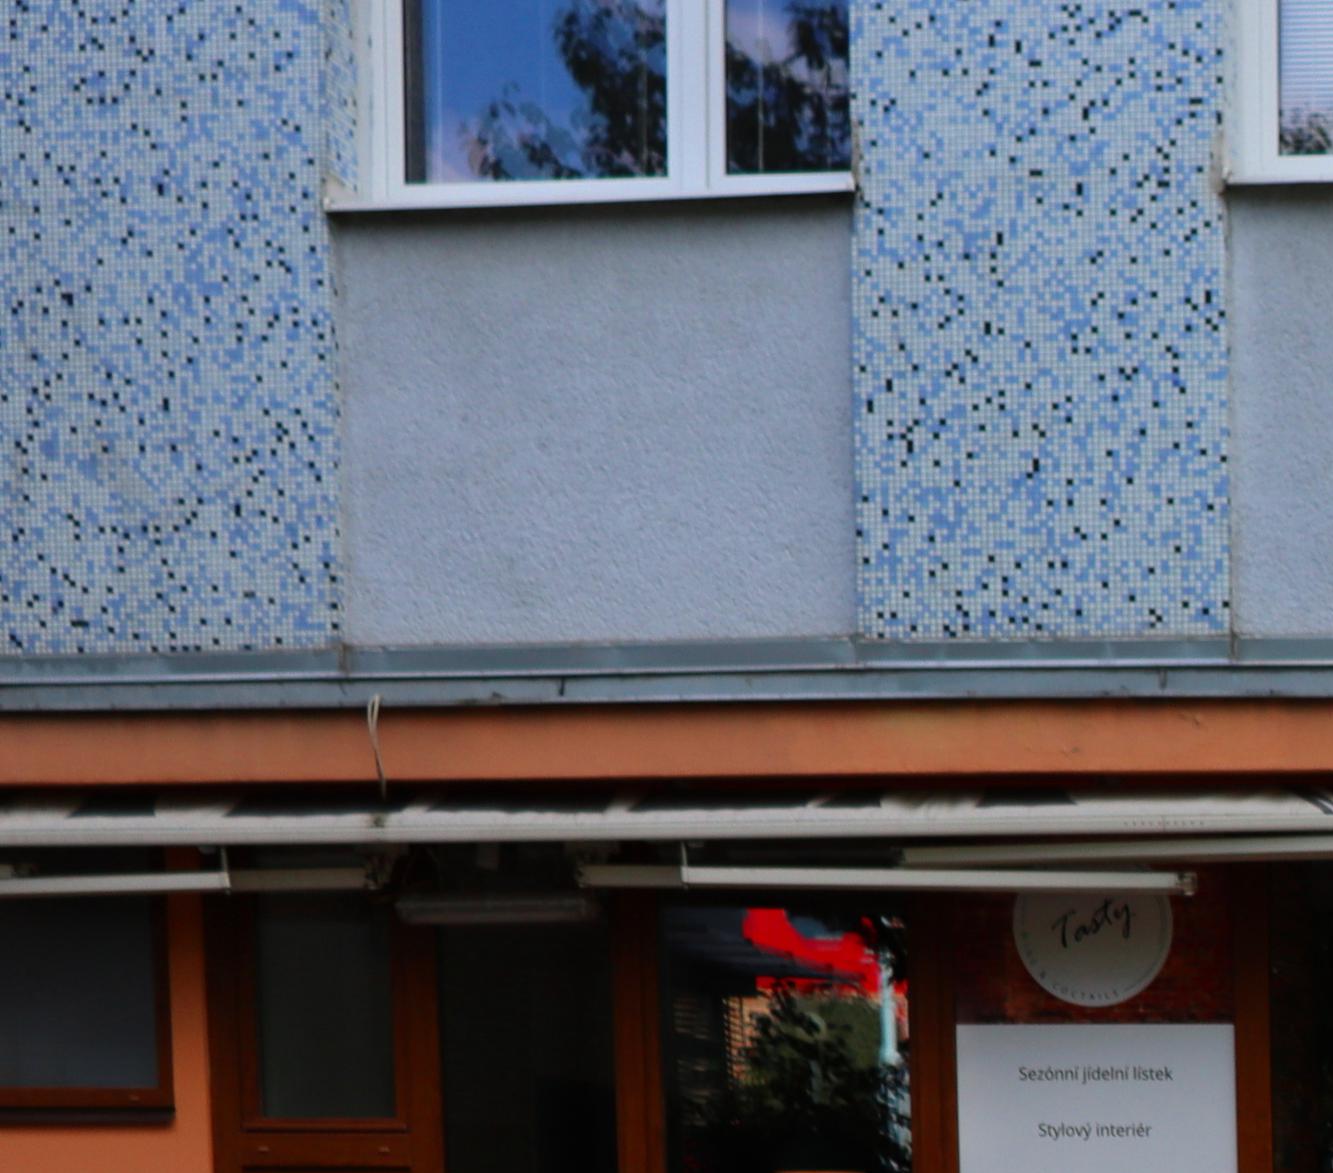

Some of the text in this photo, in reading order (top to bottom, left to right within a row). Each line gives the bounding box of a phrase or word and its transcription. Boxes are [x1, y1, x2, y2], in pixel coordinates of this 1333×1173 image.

[1052, 899, 1136, 949] Tasty
[1019, 1066, 1173, 1084] Sezónní jídelní lístek
[1038, 1122, 1152, 1141] Stylový interiér
